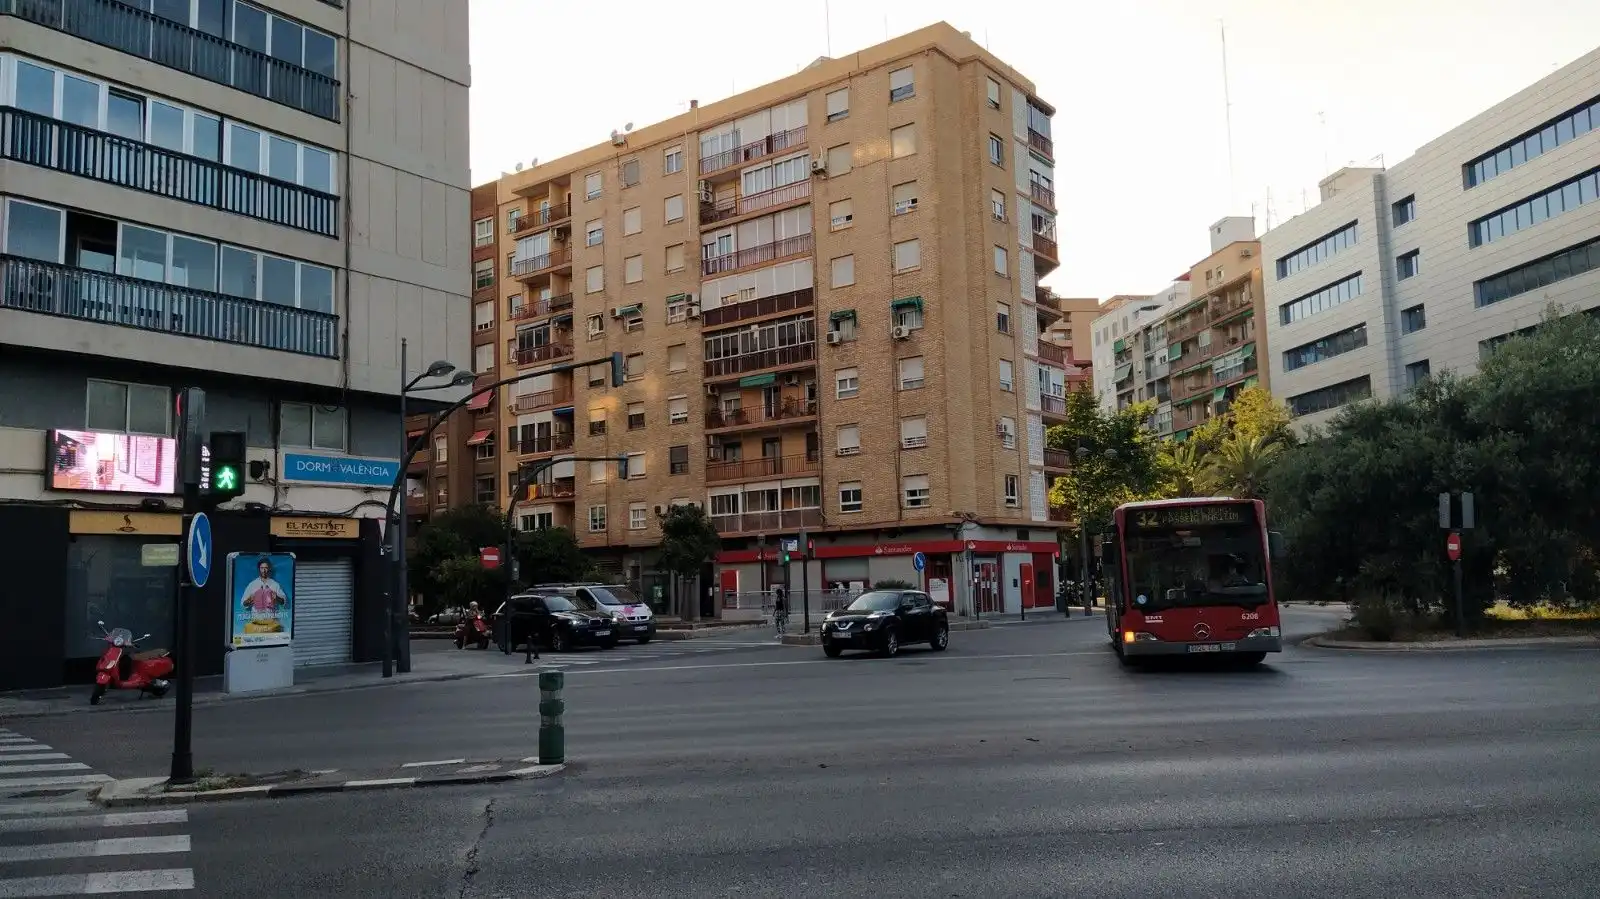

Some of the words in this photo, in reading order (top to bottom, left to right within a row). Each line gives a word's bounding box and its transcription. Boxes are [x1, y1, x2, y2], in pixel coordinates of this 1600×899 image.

[296, 460, 331, 473] DORM
[339, 463, 389, 477] VALÈNCIA
[286, 521, 299, 530] EL
[1136, 511, 1159, 527] 32
